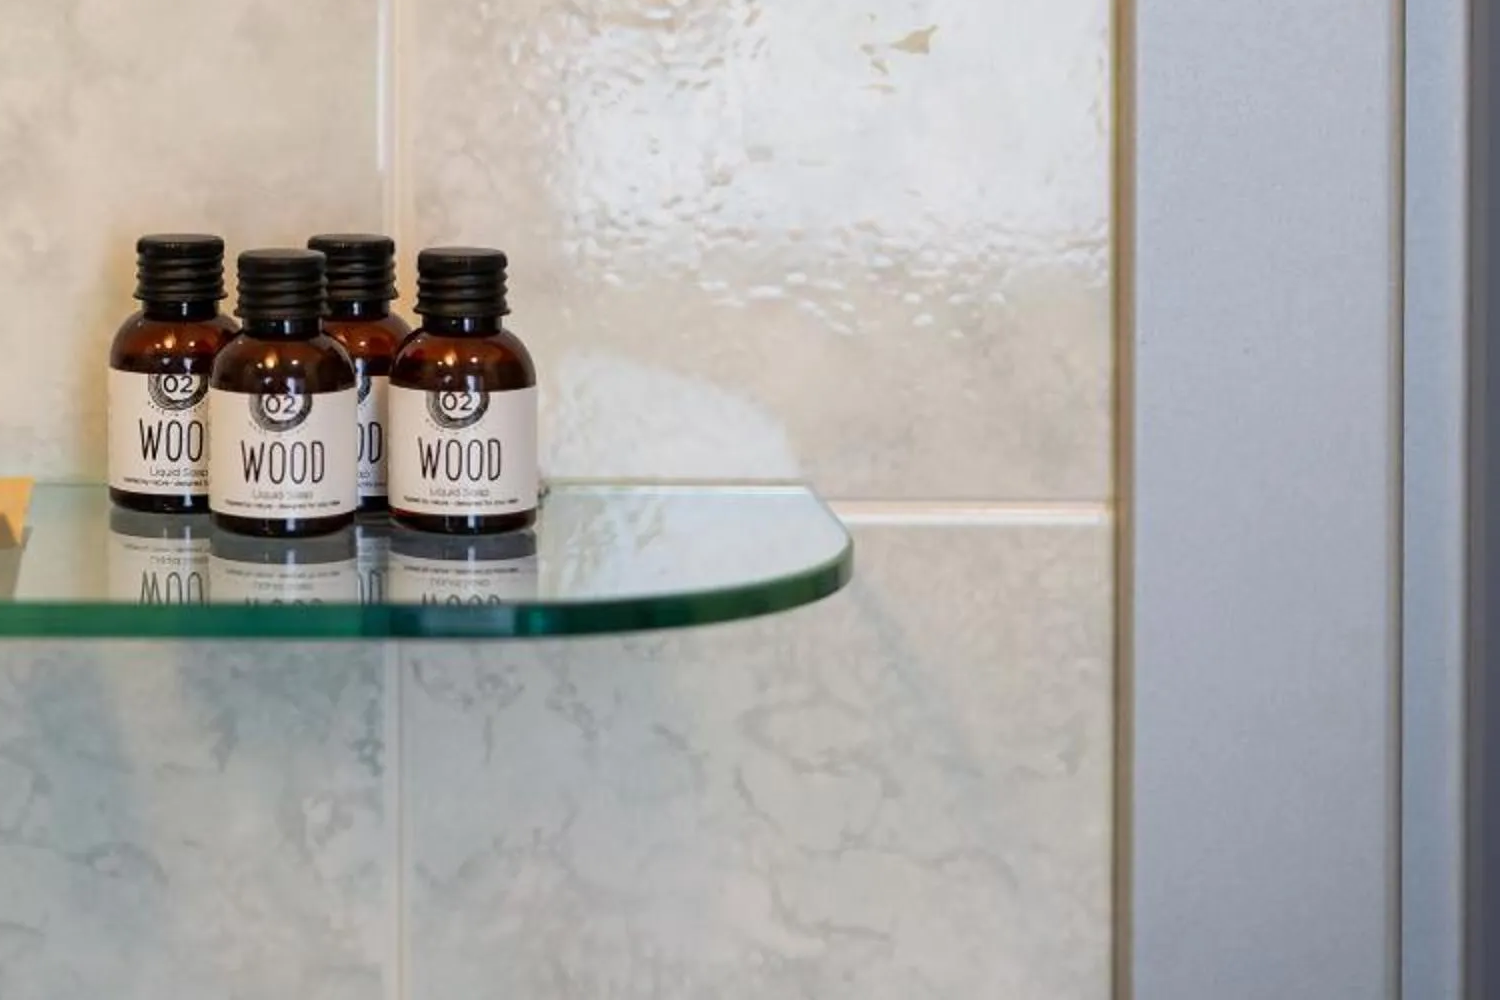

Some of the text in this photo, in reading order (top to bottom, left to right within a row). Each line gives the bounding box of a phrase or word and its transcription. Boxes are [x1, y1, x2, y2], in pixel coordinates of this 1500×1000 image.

[139, 418, 203, 462] WOO
[240, 440, 324, 484] WOOD
[417, 436, 501, 481] WOOD
